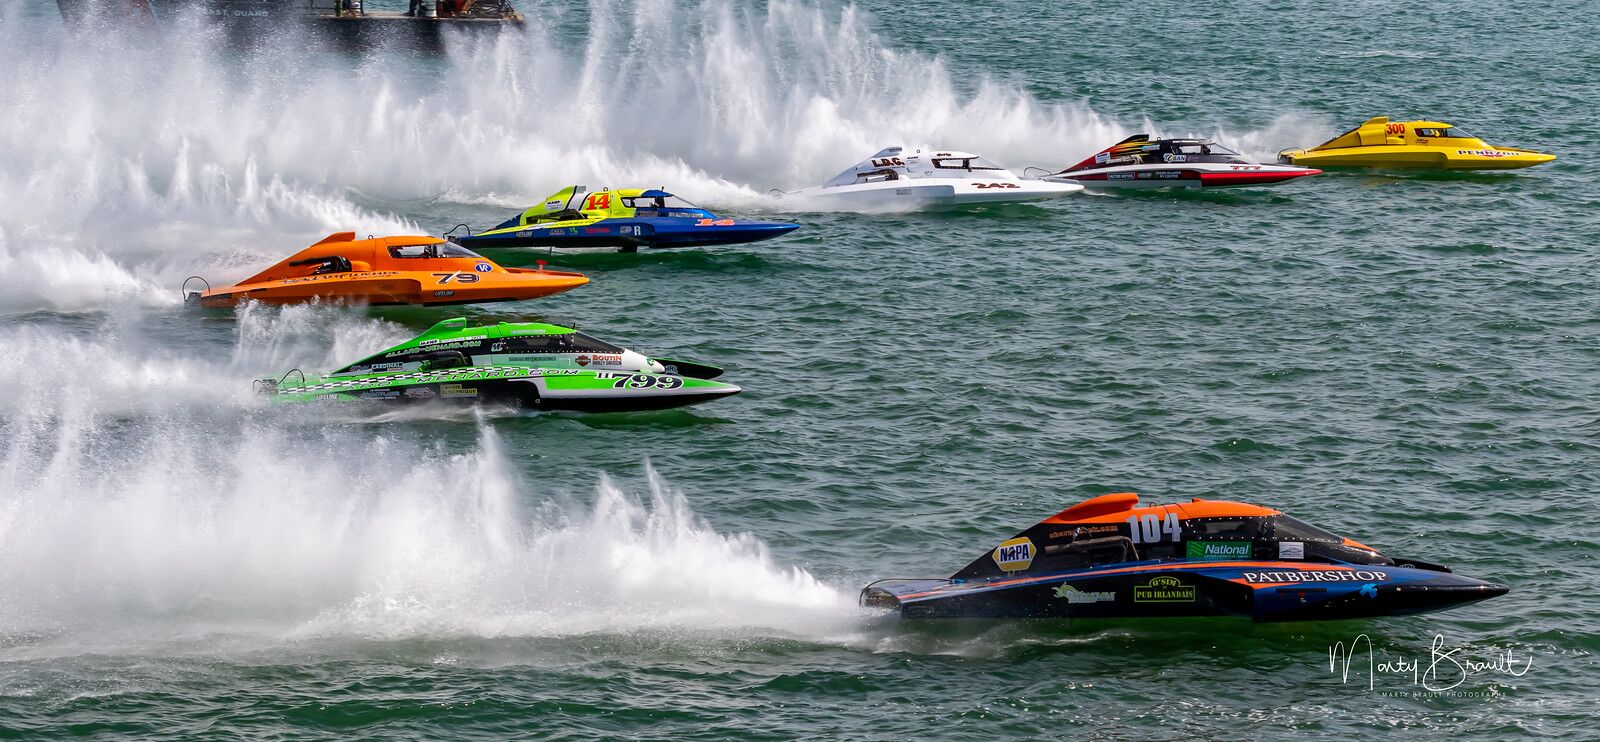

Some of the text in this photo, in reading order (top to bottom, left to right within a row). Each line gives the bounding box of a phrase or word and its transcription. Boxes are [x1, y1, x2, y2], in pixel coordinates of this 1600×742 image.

[1385, 123, 1406, 134] 300
[586, 193, 610, 210] 14
[478, 264, 489, 272] VR
[430, 270, 480, 284] 79
[1125, 513, 1182, 543] 104
[1000, 544, 1030, 562] NAPA
[1205, 544, 1249, 554] National
[1243, 570, 1387, 583] PATBERSHOP
